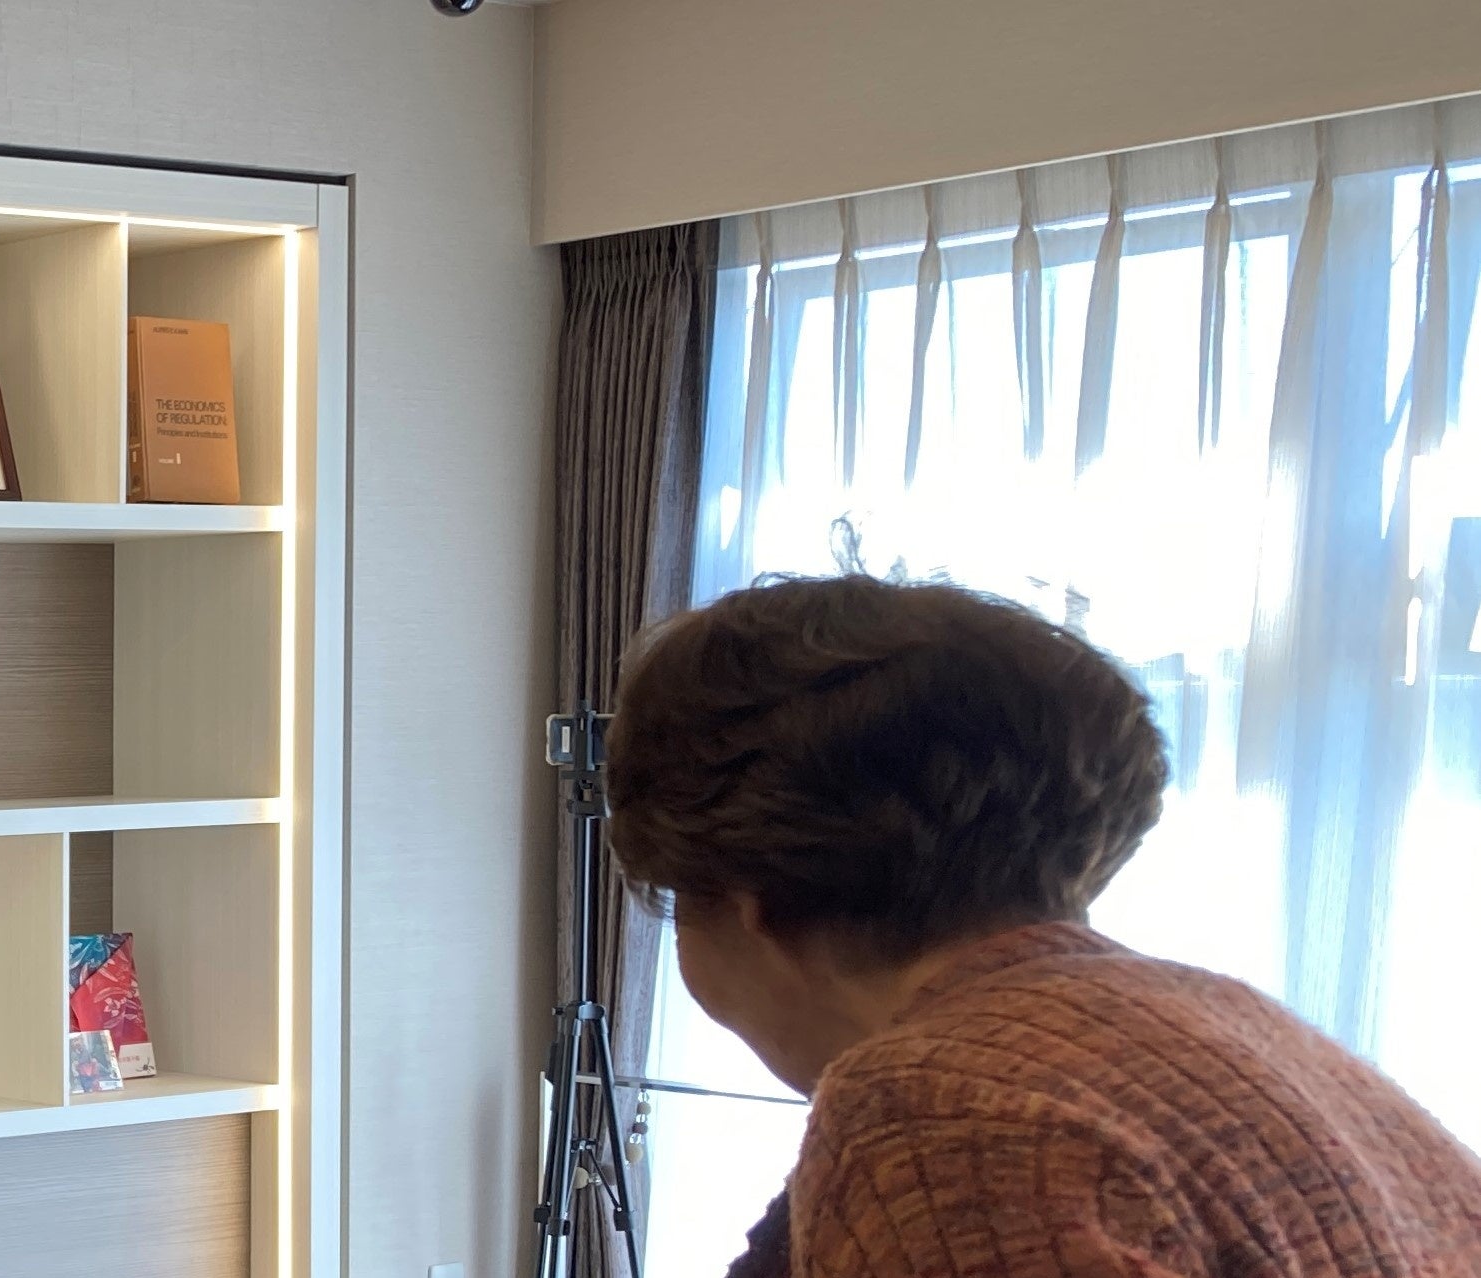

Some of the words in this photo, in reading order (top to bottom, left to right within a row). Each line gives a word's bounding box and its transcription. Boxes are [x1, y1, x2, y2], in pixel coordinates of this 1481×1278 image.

[156, 398, 172, 410] THE
[173, 399, 226, 412] ECONOMICS
[156, 412, 168, 424] OF
